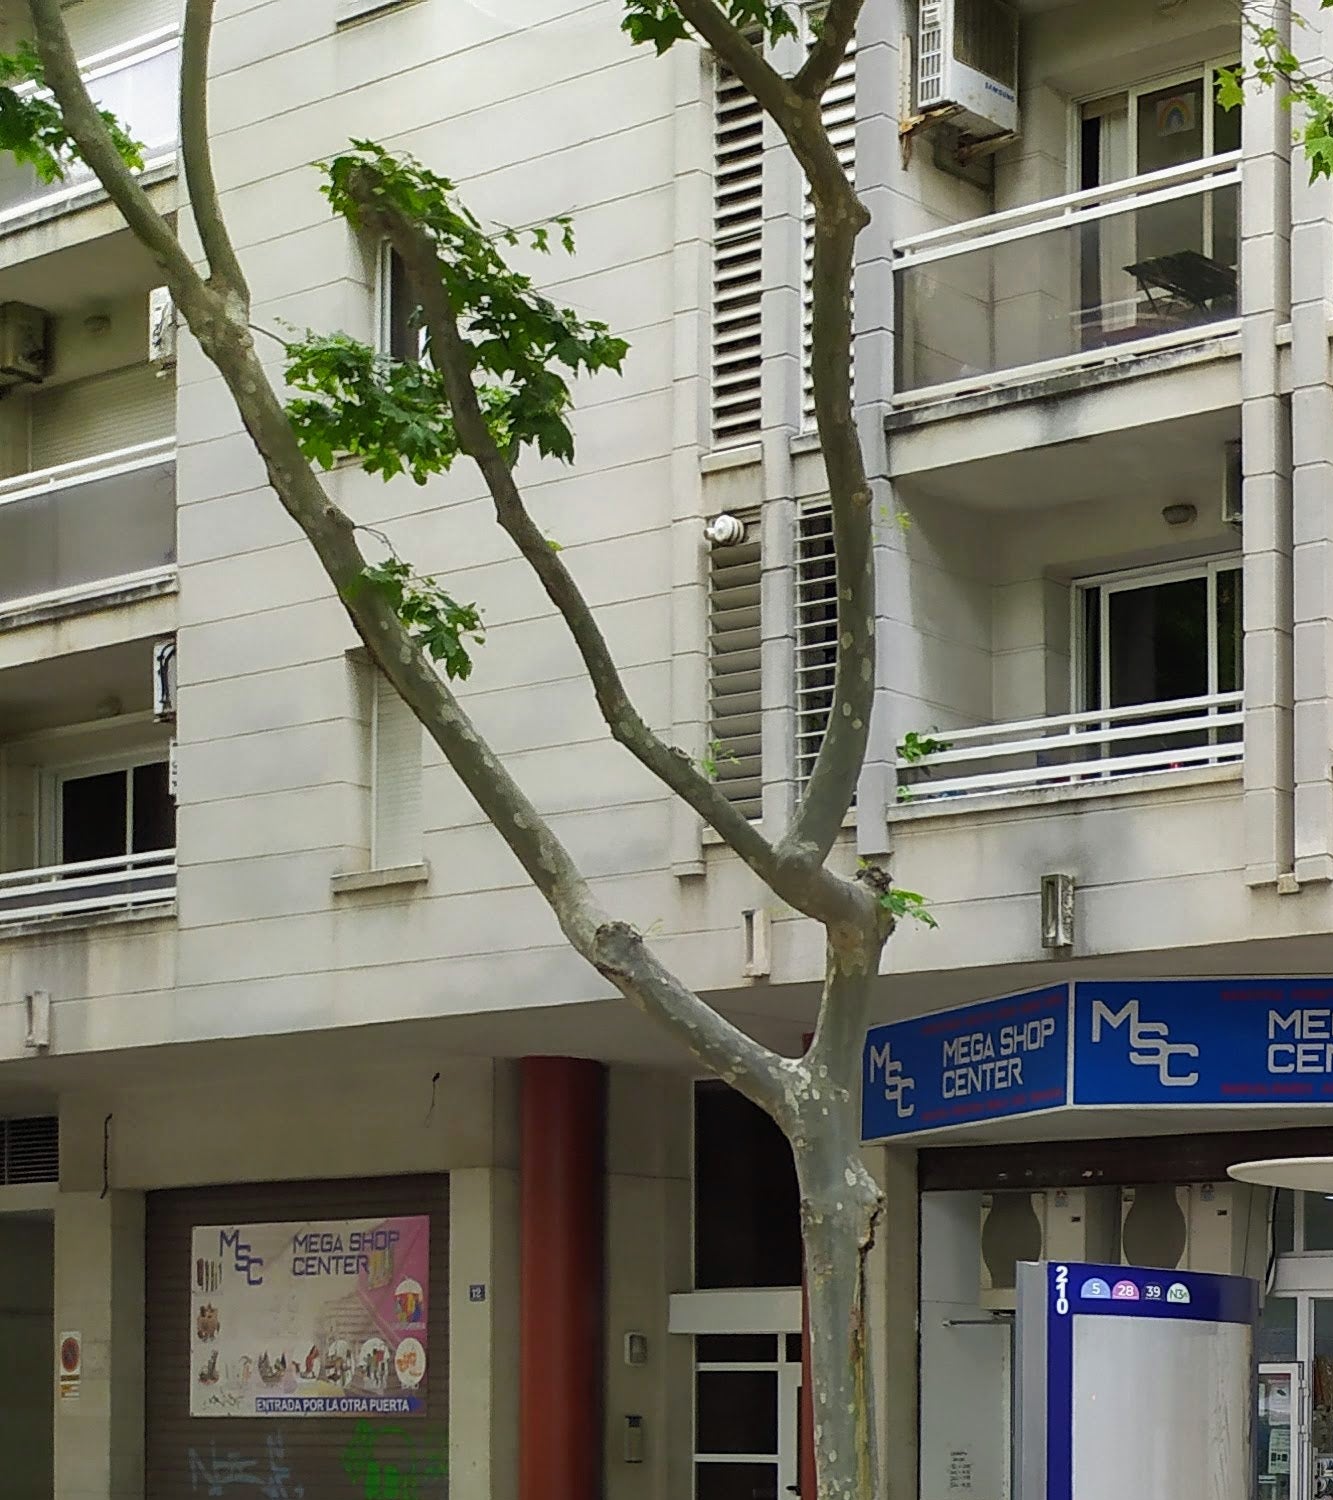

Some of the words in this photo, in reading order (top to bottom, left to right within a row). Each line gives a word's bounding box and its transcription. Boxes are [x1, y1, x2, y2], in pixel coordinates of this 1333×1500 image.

[942, 1032, 995, 1067] MEGA
[1000, 1017, 1055, 1056] SHOP
[942, 1057, 1024, 1099] CENTER
[292, 1232, 342, 1253] MEGA
[349, 1230, 401, 1251] SHOP
[292, 1253, 370, 1276] CENTER
[1091, 1283, 1101, 1294] 5
[1117, 1284, 1135, 1297] 28
[1145, 1285, 1161, 1298] 39
[256, 1398, 302, 1412] ENTRADA
[303, 1399, 326, 1411] POR
[326, 1398, 340, 1411] LA
[341, 1398, 367, 1411] OTRA
[369, 1398, 410, 1411] PUERTA
